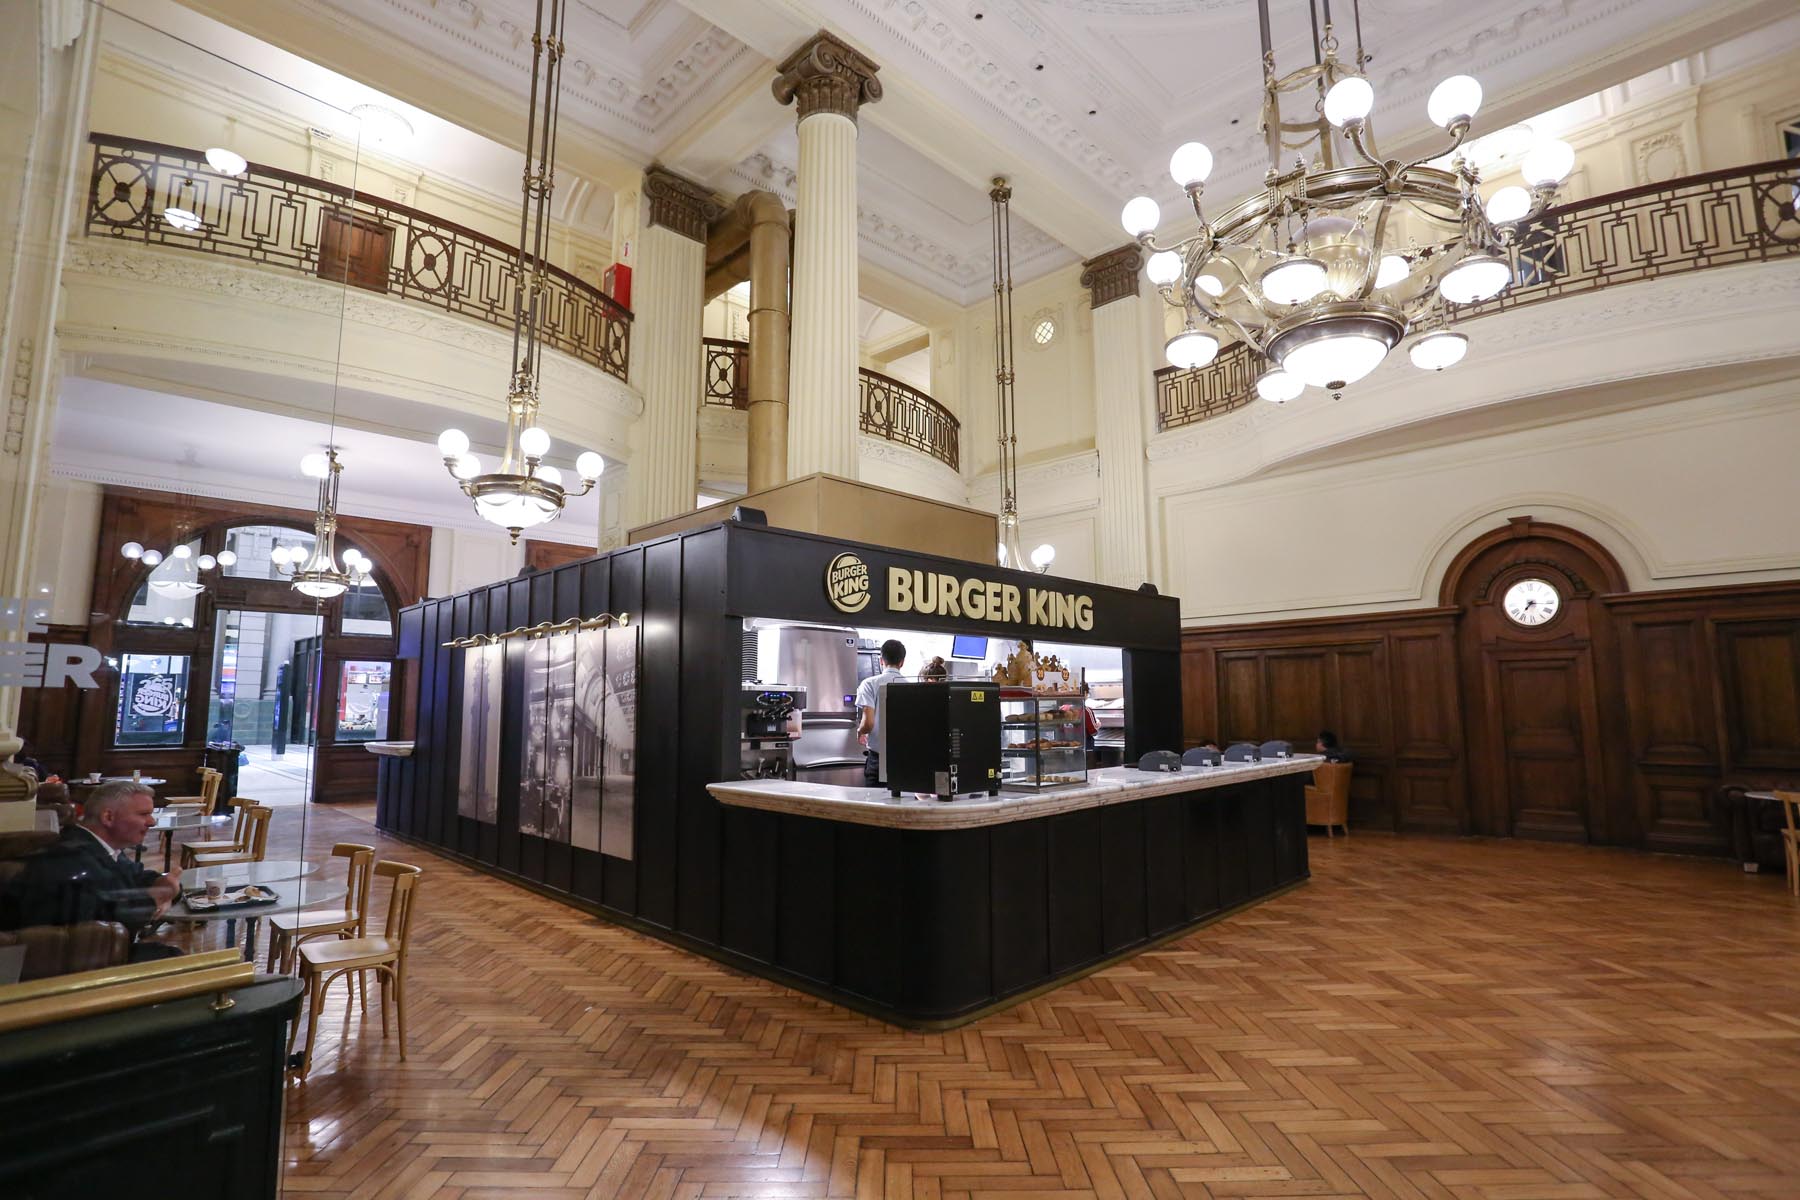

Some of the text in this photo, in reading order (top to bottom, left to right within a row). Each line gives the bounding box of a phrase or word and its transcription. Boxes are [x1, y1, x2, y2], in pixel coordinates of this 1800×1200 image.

[832, 565, 867, 584] BURGER
[833, 575, 868, 599] KING
[888, 566, 1094, 631] BURGER KING
